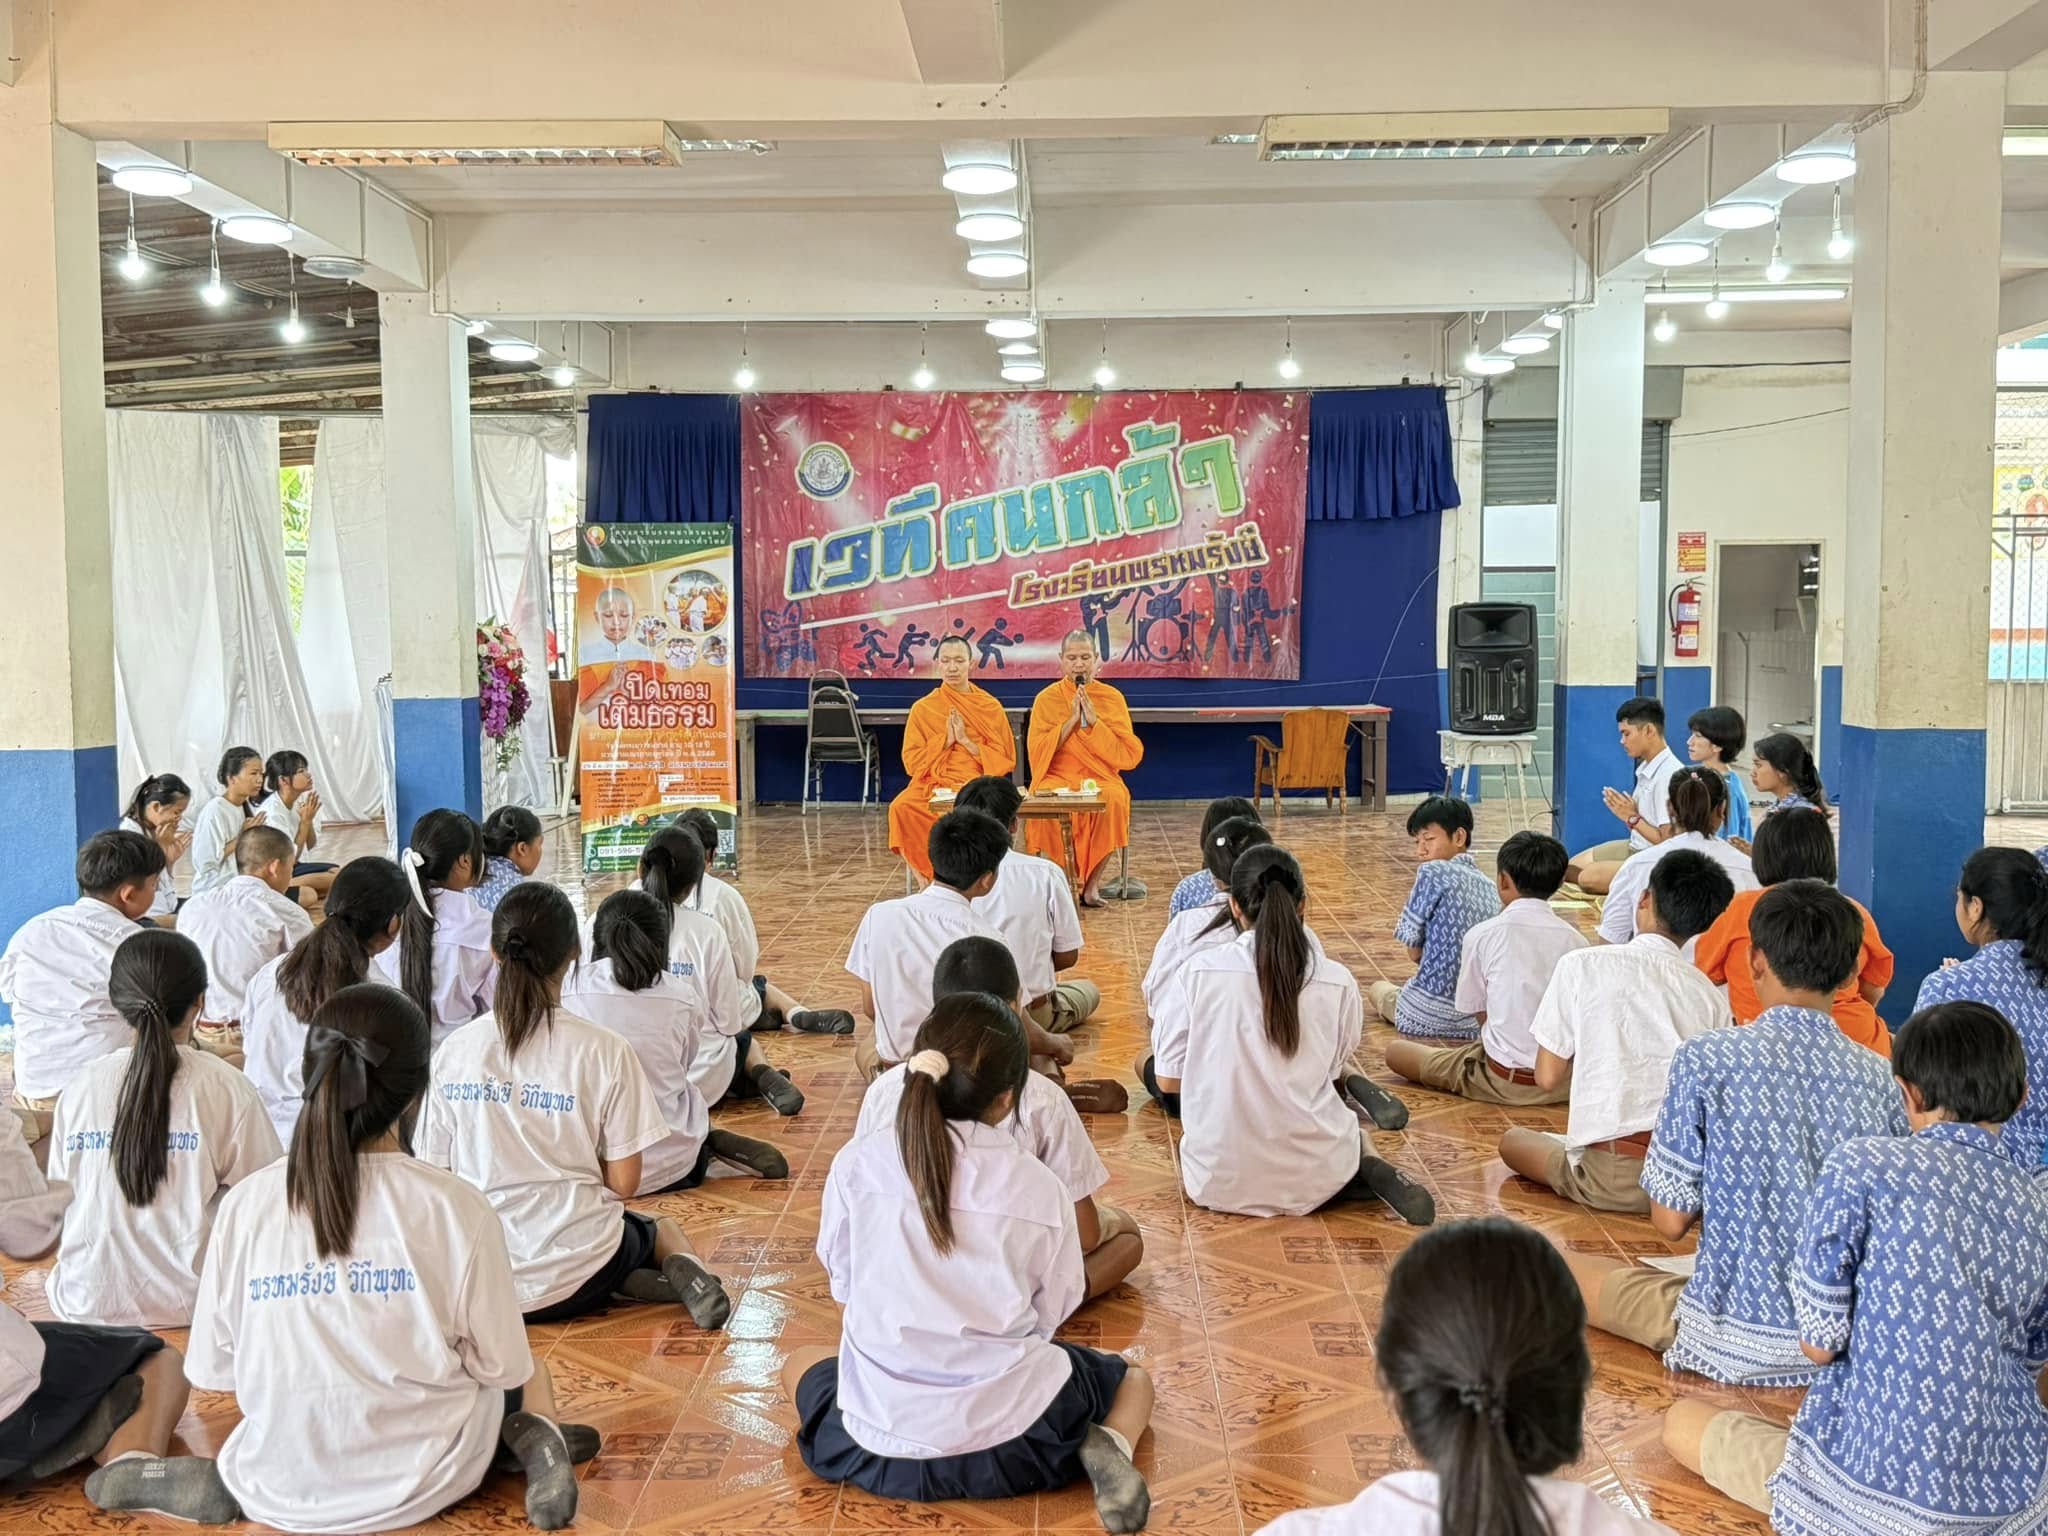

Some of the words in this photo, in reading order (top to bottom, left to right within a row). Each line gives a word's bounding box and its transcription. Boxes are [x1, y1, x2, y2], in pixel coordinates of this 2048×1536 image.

[787, 424, 1242, 596] เวทีคนกล้า
[625, 672, 710, 701] ปิดเทอม
[600, 694, 716, 728] เติมธรรม
[443, 1077, 513, 1103] พรหมรังษี
[520, 1083, 575, 1117] วิถีพุทธ
[249, 1261, 336, 1301] พรหมรังษี
[348, 1260, 415, 1301] วิถีพุทธ
